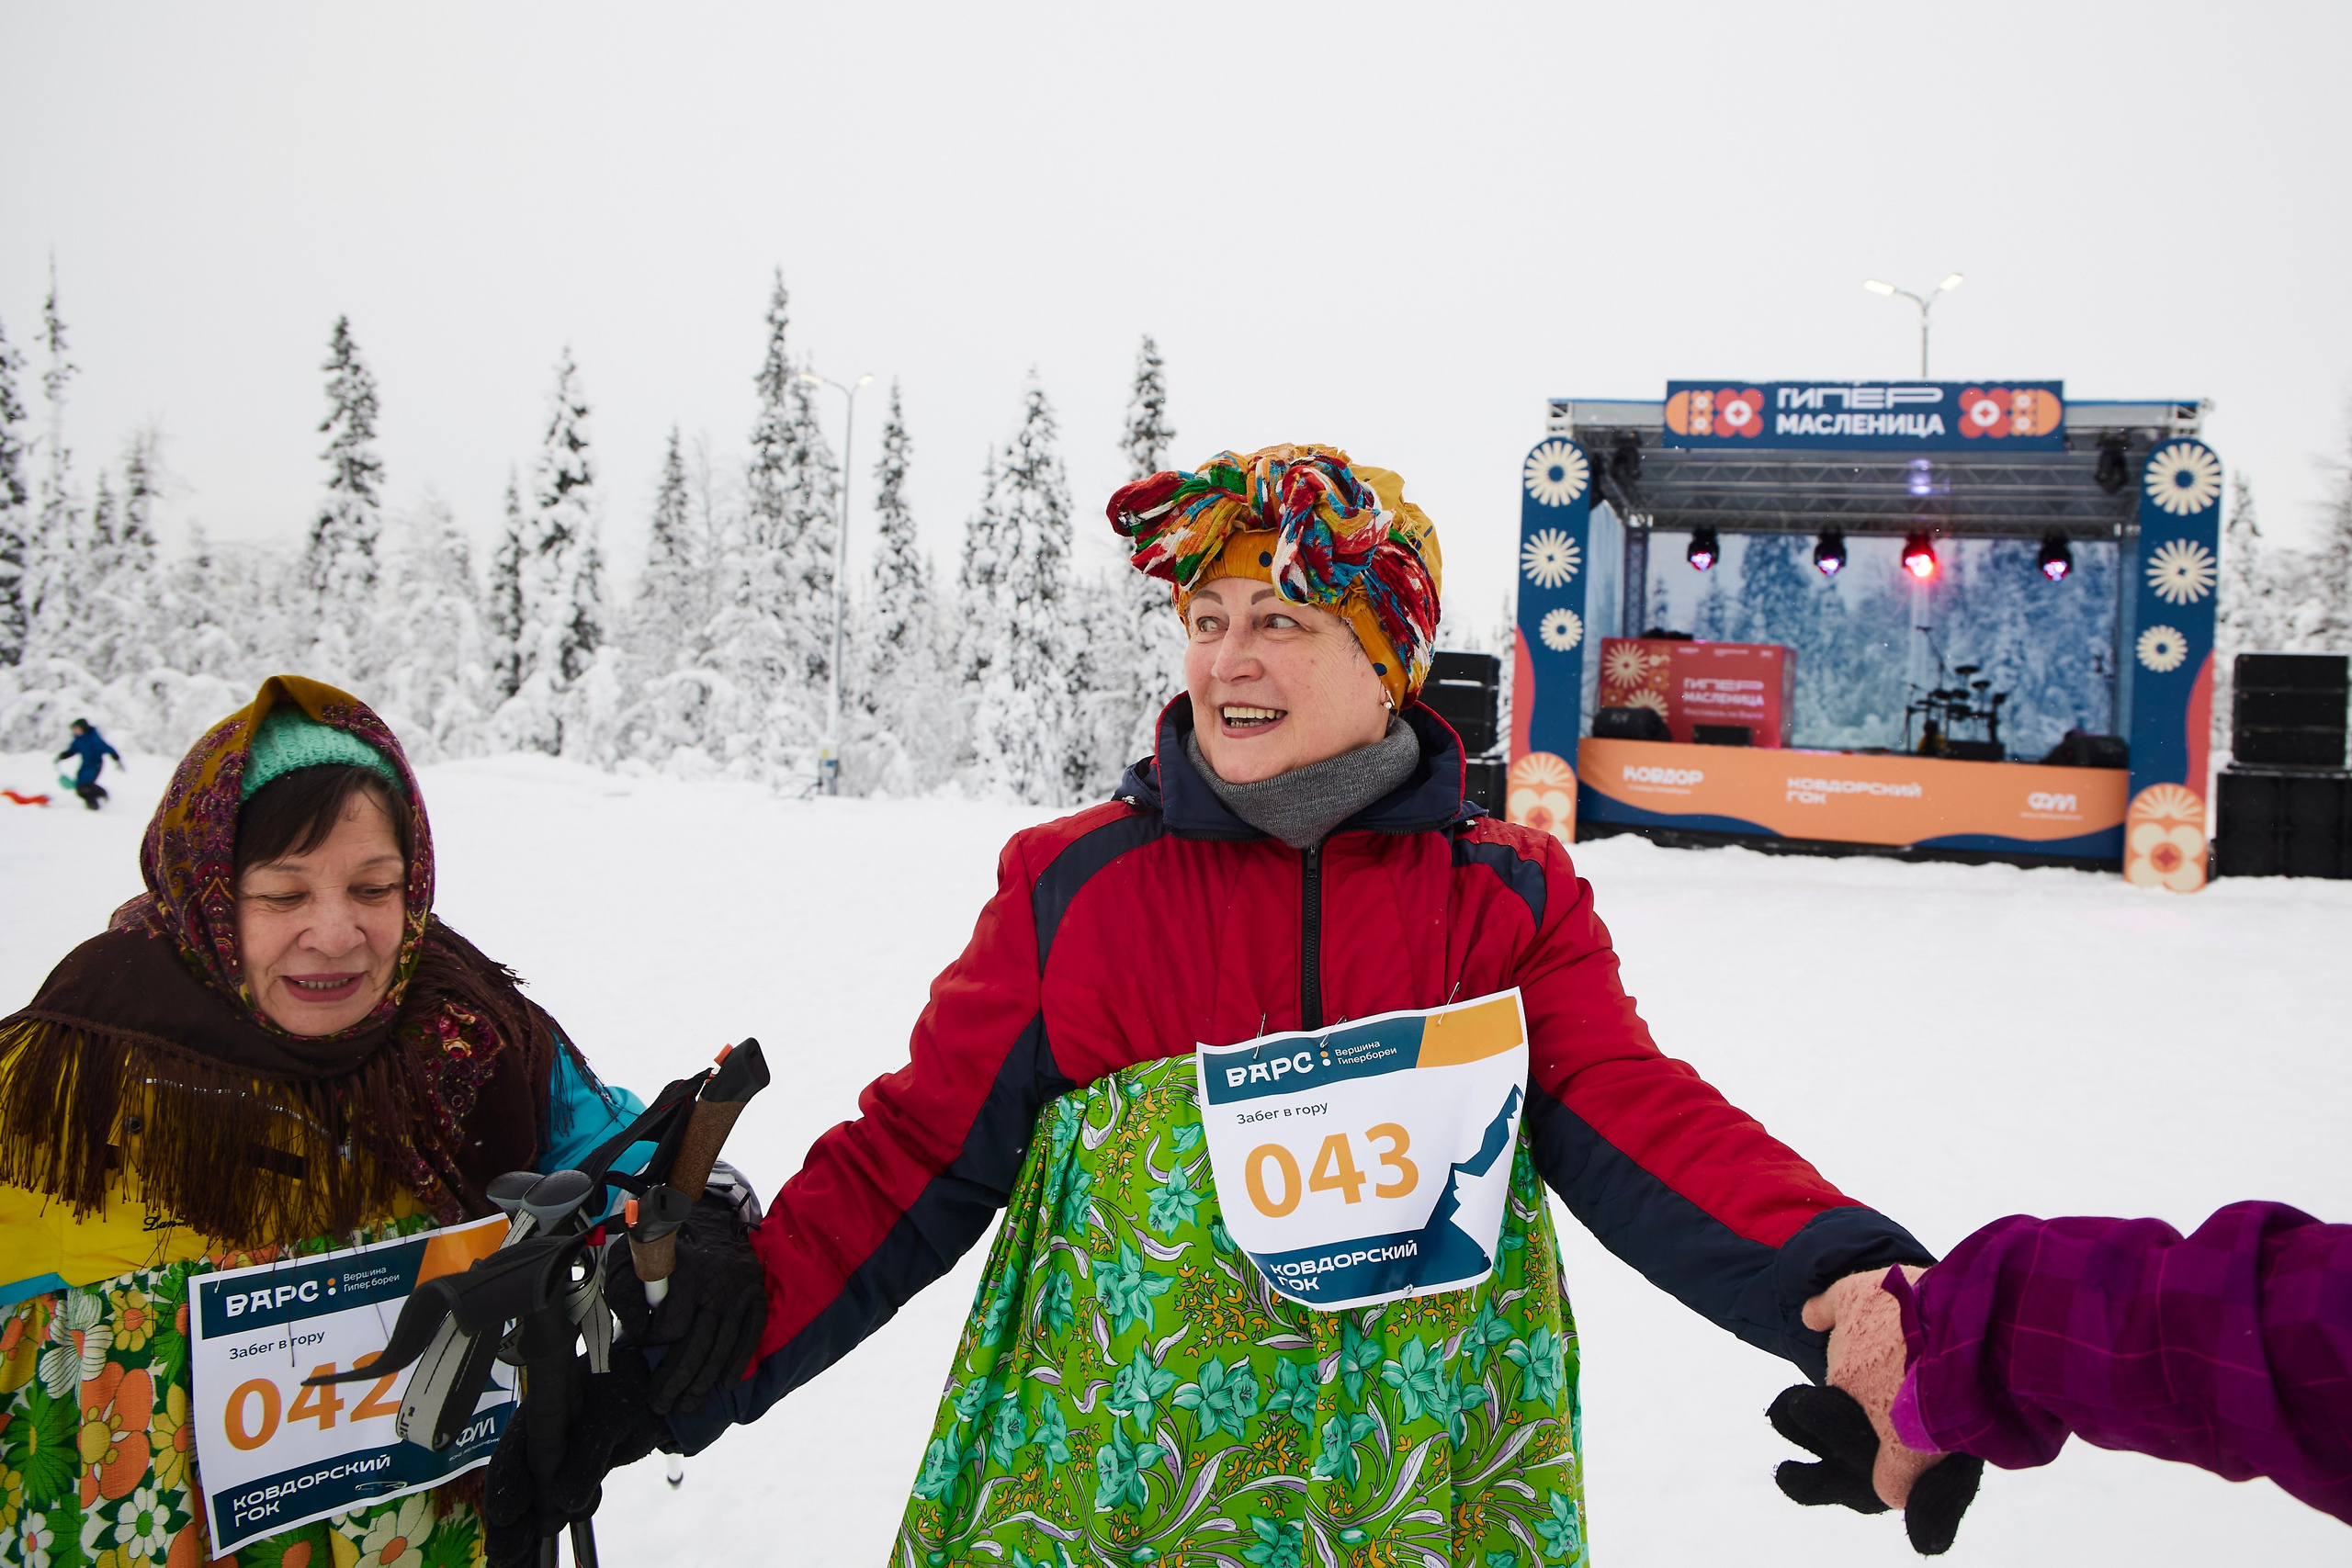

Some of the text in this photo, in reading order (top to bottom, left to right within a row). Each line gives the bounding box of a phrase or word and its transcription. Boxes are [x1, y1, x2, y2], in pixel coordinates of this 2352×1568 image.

[1777, 388, 1944, 410] ГИПЕР
[1776, 413, 1946, 438] МАСЛЕНИЦА
[1623, 765, 1704, 785] КОВДОР
[1786, 777, 1923, 798] КОВДОРСКИЙ
[1786, 790, 1827, 805] ГОК
[1335, 1040, 1381, 1057] Вершина
[1338, 1046, 1397, 1066] Гипербореи
[1226, 1052, 1315, 1088] ВАРС
[1237, 1101, 1329, 1125] Забег в гору
[1245, 1122, 1419, 1218] 043
[1270, 1240, 1418, 1276] КОВДОРСКИЙ
[344, 1266, 387, 1282] Вершина
[344, 1273, 400, 1293] Гипербореи
[1277, 1276, 1320, 1292] ГОК
[225, 1280, 320, 1318] ВАРС
[230, 1331, 325, 1359] Забег в гору
[224, 1351, 401, 1451] 042
[233, 1453, 391, 1511] КОВДОРСКИЙ
[234, 1500, 281, 1528] ГОК
